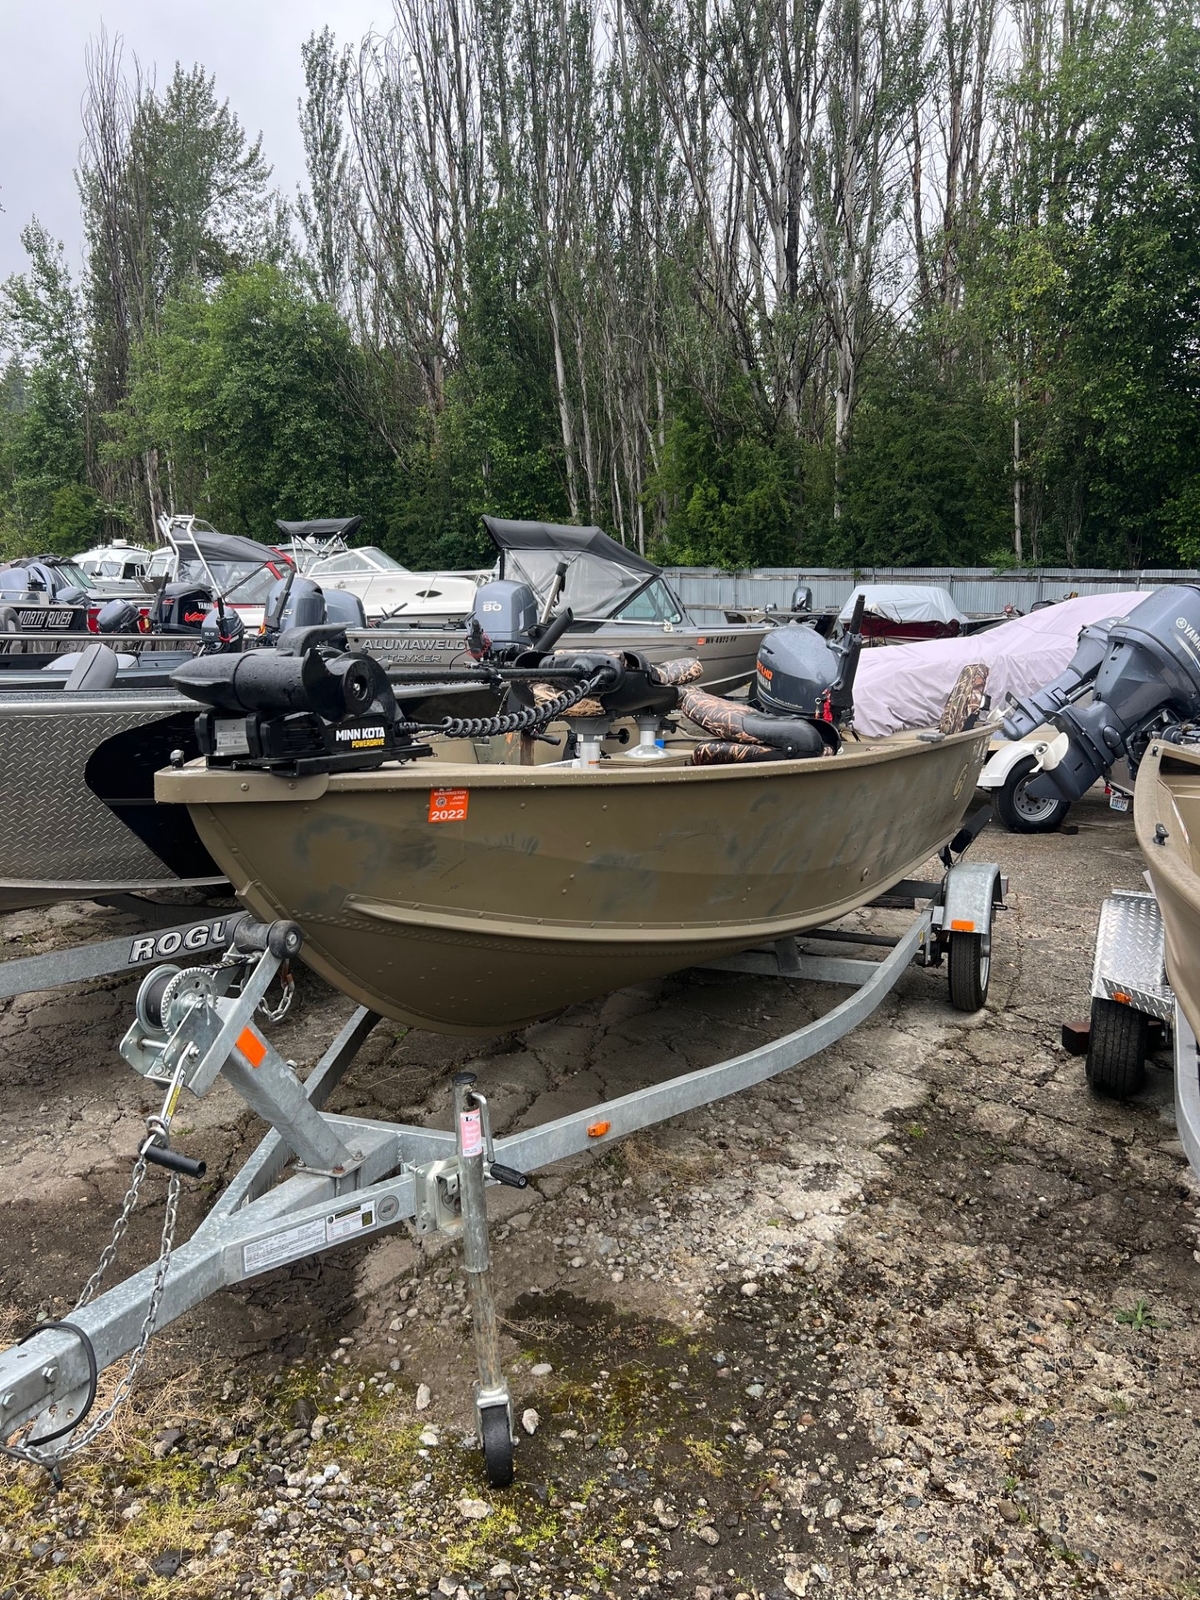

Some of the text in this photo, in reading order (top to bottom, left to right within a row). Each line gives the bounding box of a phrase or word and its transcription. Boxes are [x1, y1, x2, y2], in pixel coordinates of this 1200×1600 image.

[482, 603, 503, 612] 80
[18, 610, 73, 628] NORTH RIVER
[361, 639, 466, 651] ALUMAWELD
[335, 726, 386, 741] MINN KOTA
[351, 738, 385, 748] POWERDRIVE
[431, 808, 465, 821] 2022
[128, 921, 226, 964] ROGU
